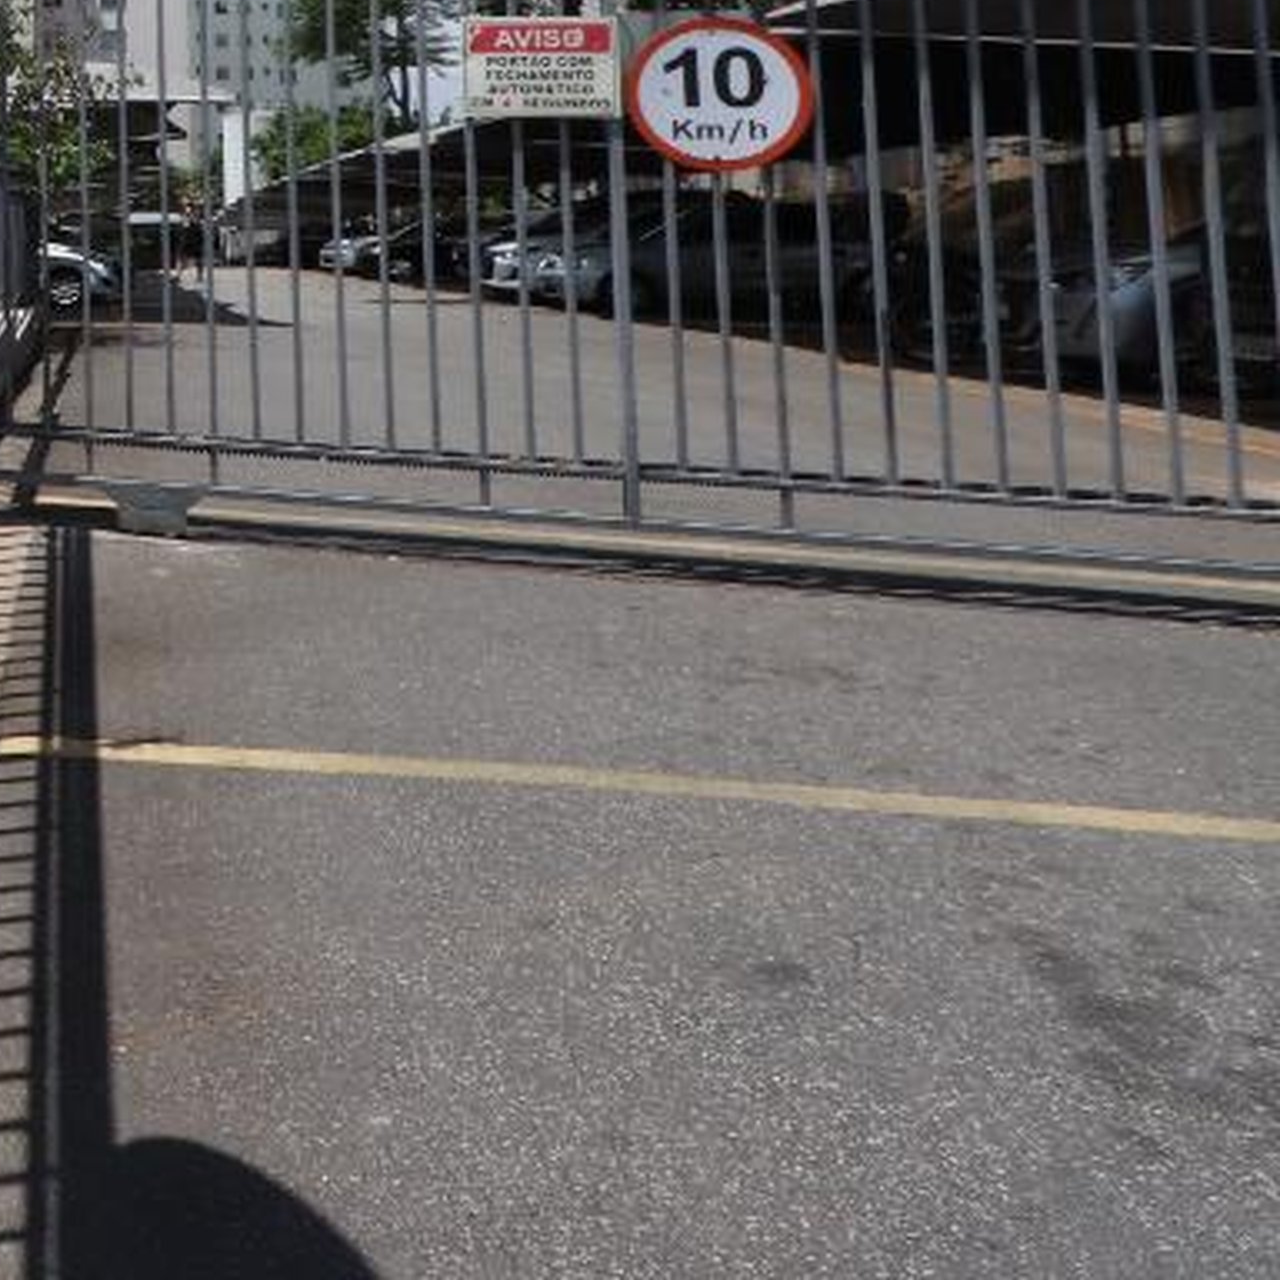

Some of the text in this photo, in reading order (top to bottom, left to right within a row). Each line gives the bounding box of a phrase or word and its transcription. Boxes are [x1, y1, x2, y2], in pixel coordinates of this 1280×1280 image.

[494, 27, 584, 49] AVISO
[485, 69, 595, 81] FECHAMENTO
[663, 46, 767, 108] 10
[672, 119, 768, 144] Km/h
